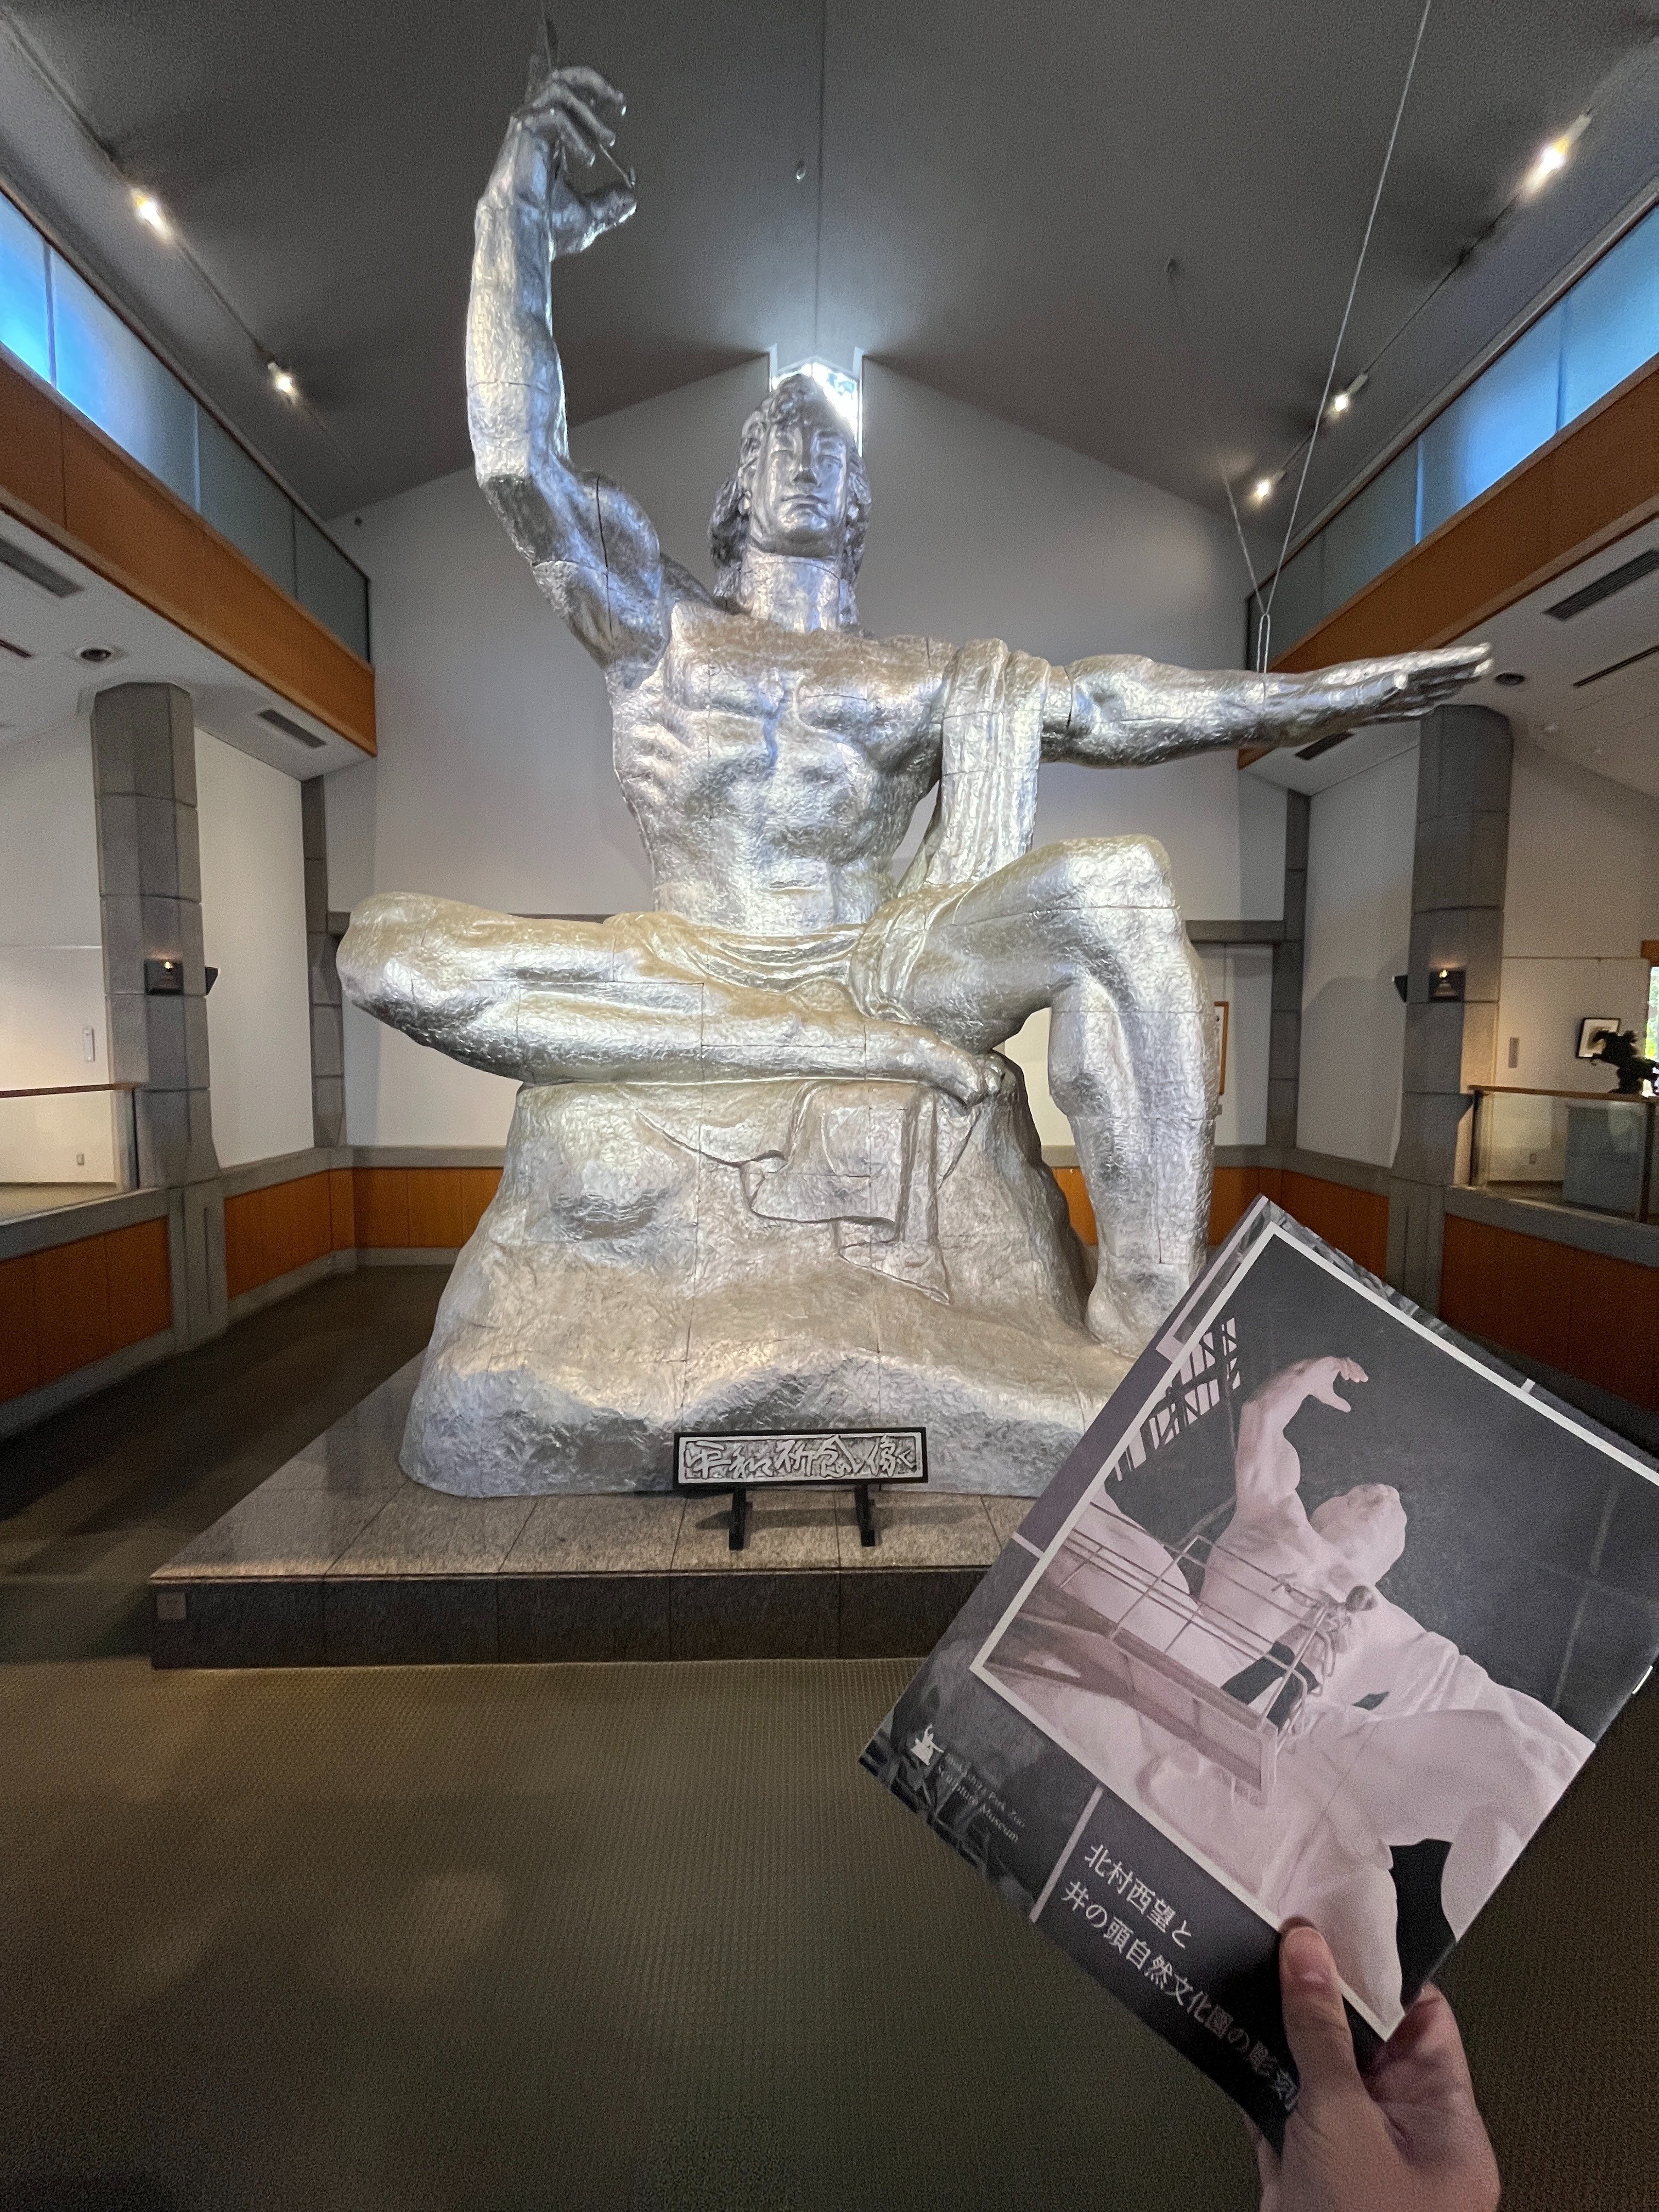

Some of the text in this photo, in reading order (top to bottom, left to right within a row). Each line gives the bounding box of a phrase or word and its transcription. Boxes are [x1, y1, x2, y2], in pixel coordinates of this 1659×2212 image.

[979, 1804, 1018, 1842] Museum
[1084, 1844, 1192, 1949] 北村西望と
